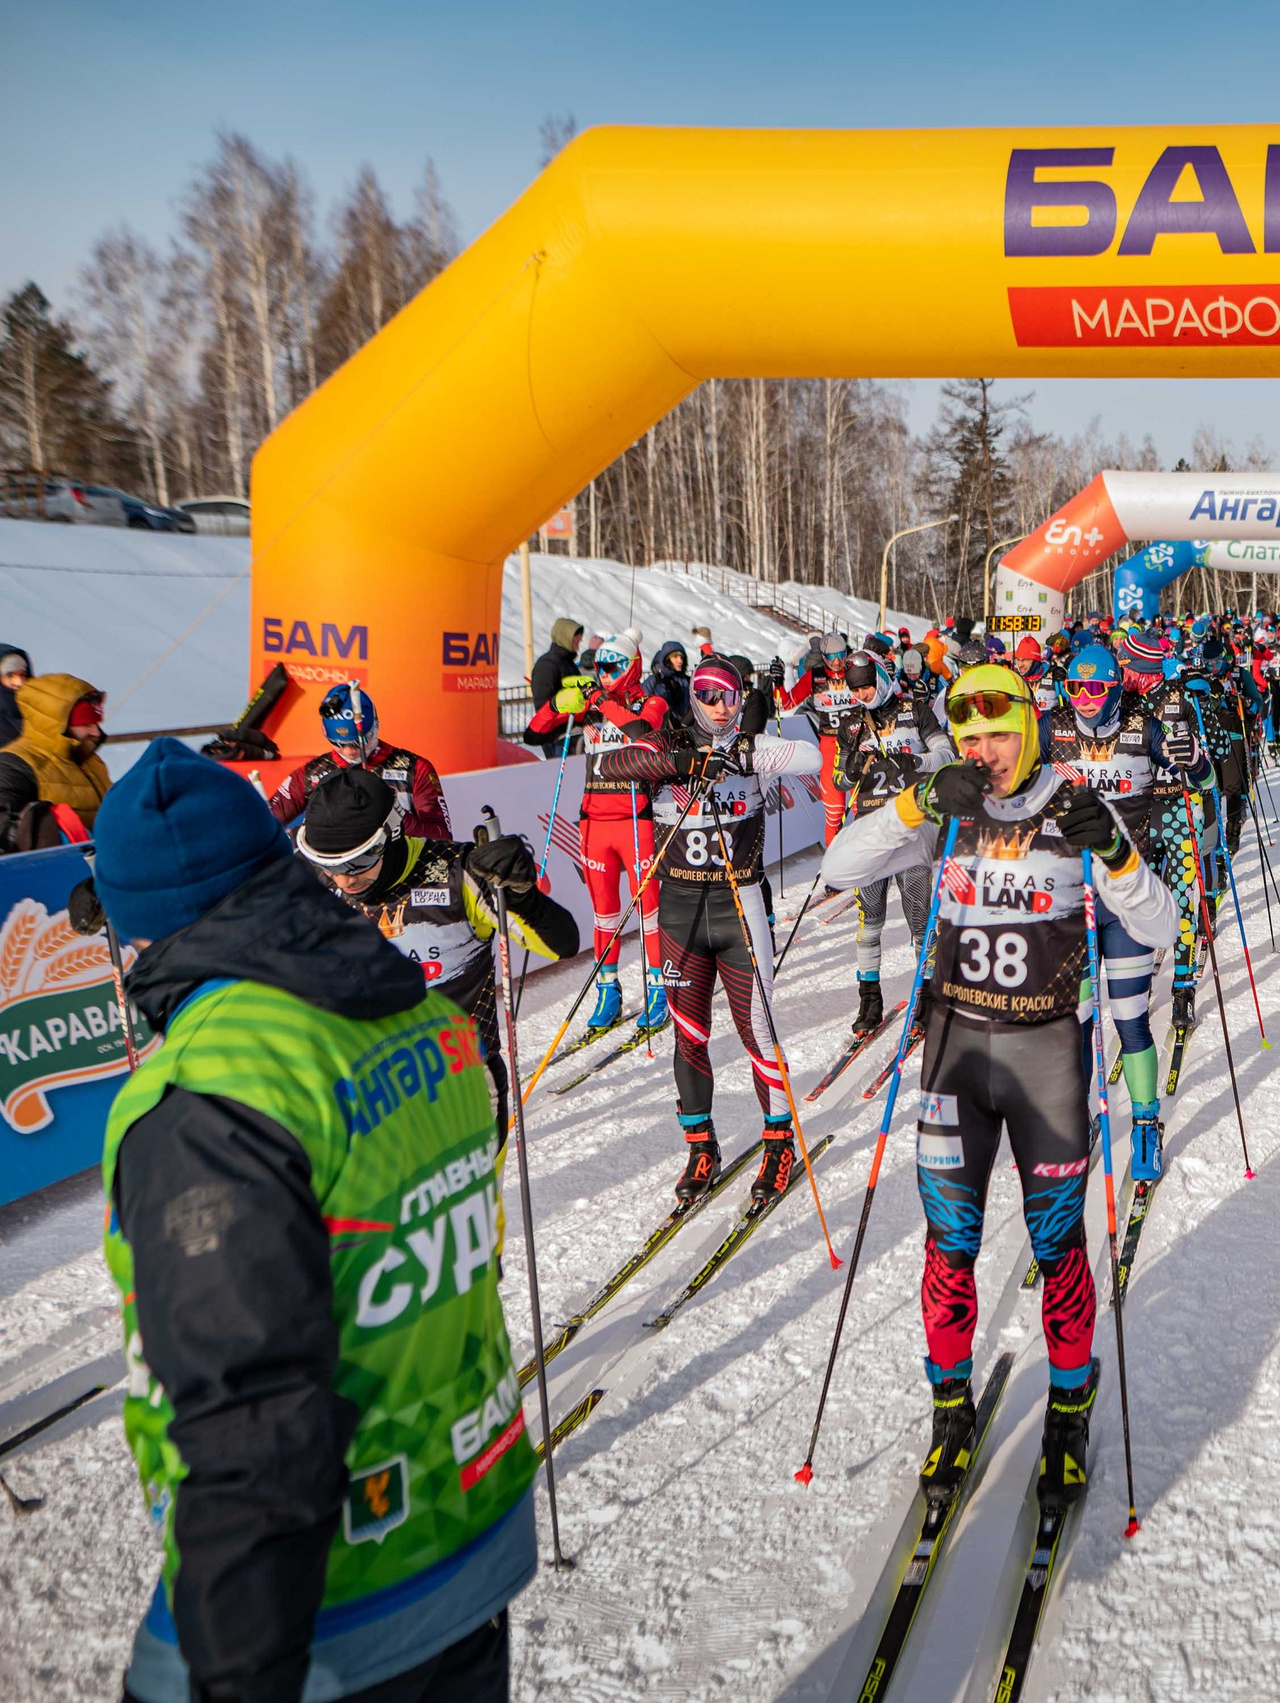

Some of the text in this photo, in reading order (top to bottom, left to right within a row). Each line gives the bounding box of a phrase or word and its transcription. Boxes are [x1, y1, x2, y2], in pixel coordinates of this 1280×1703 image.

[264, 617, 368, 661] БАМ
[443, 631, 498, 667] БА
[1087, 769, 1132, 779] KRAS
[1087, 779, 1132, 794] LAND
[685, 830, 733, 866] 83
[669, 868, 723, 882] КОРОЛЕВСКИЕ
[983, 871, 1056, 891] KRAS
[982, 887, 1053, 913] LAND
[959, 928, 1028, 988] 38
[943, 982, 1054, 1011] КОРОЛЕВСКИЕ КРАСКИ
[1032, 1155, 1088, 1178] KV+
